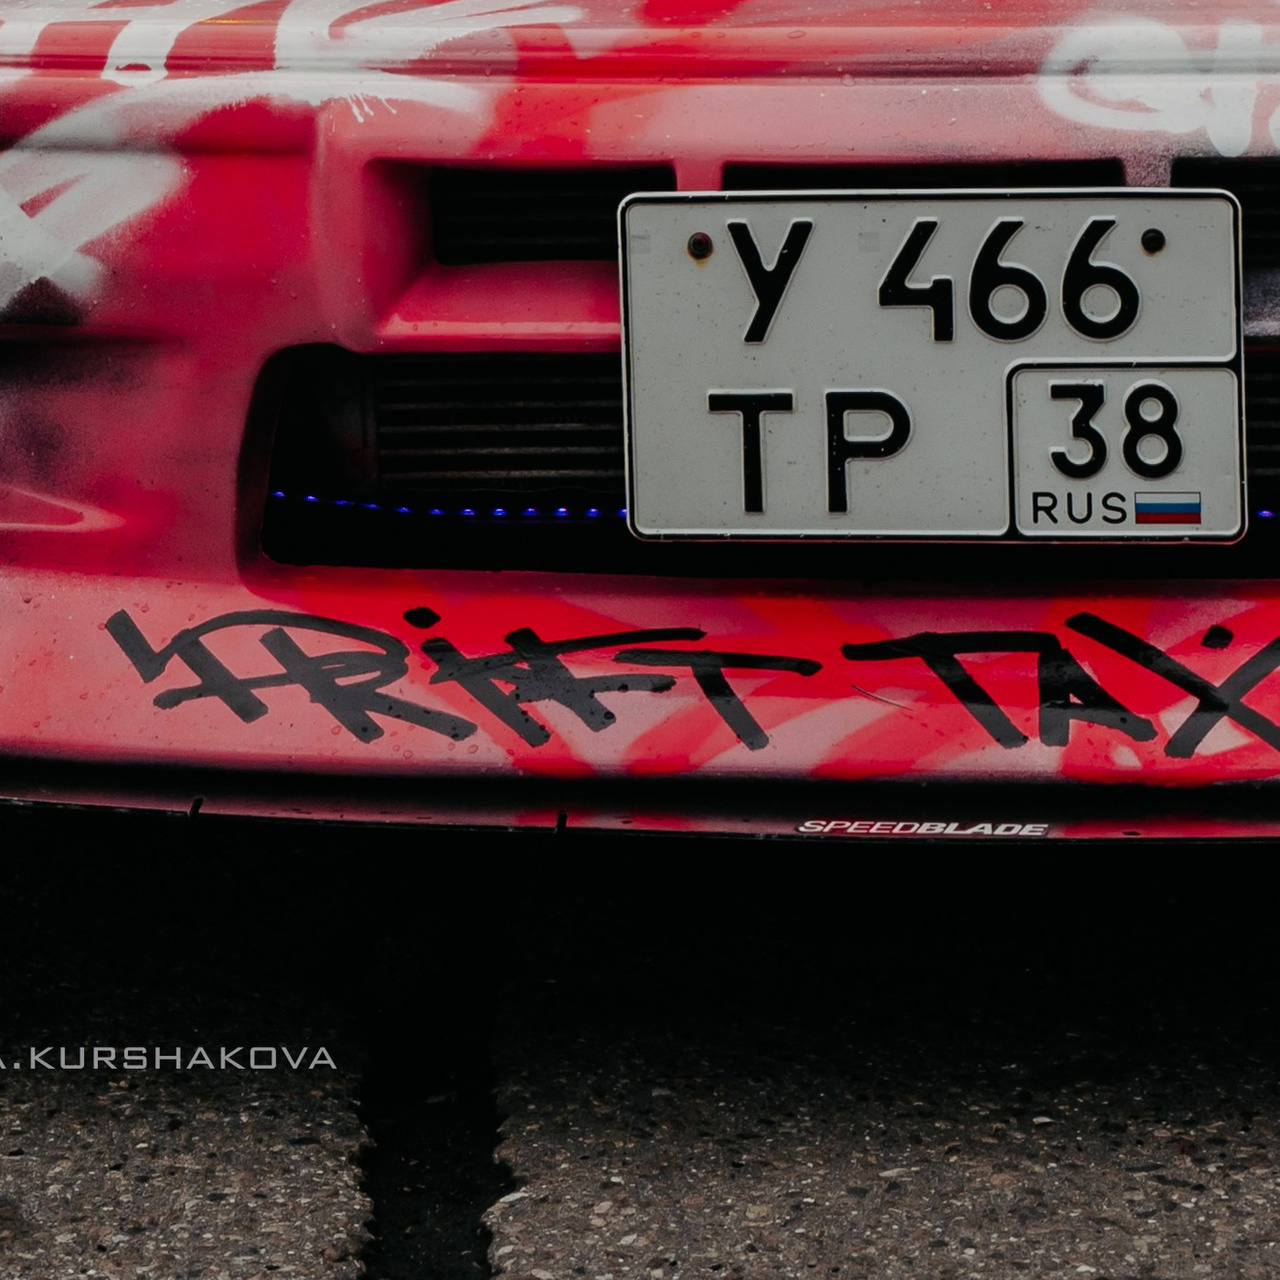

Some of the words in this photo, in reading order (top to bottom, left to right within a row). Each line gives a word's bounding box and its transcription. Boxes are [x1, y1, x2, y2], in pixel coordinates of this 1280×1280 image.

[877, 216, 1141, 343] 466
[1049, 381, 1184, 479] 38
[1032, 491, 1127, 525] RUS
[799, 820, 1049, 836] SPEEDBLADE
